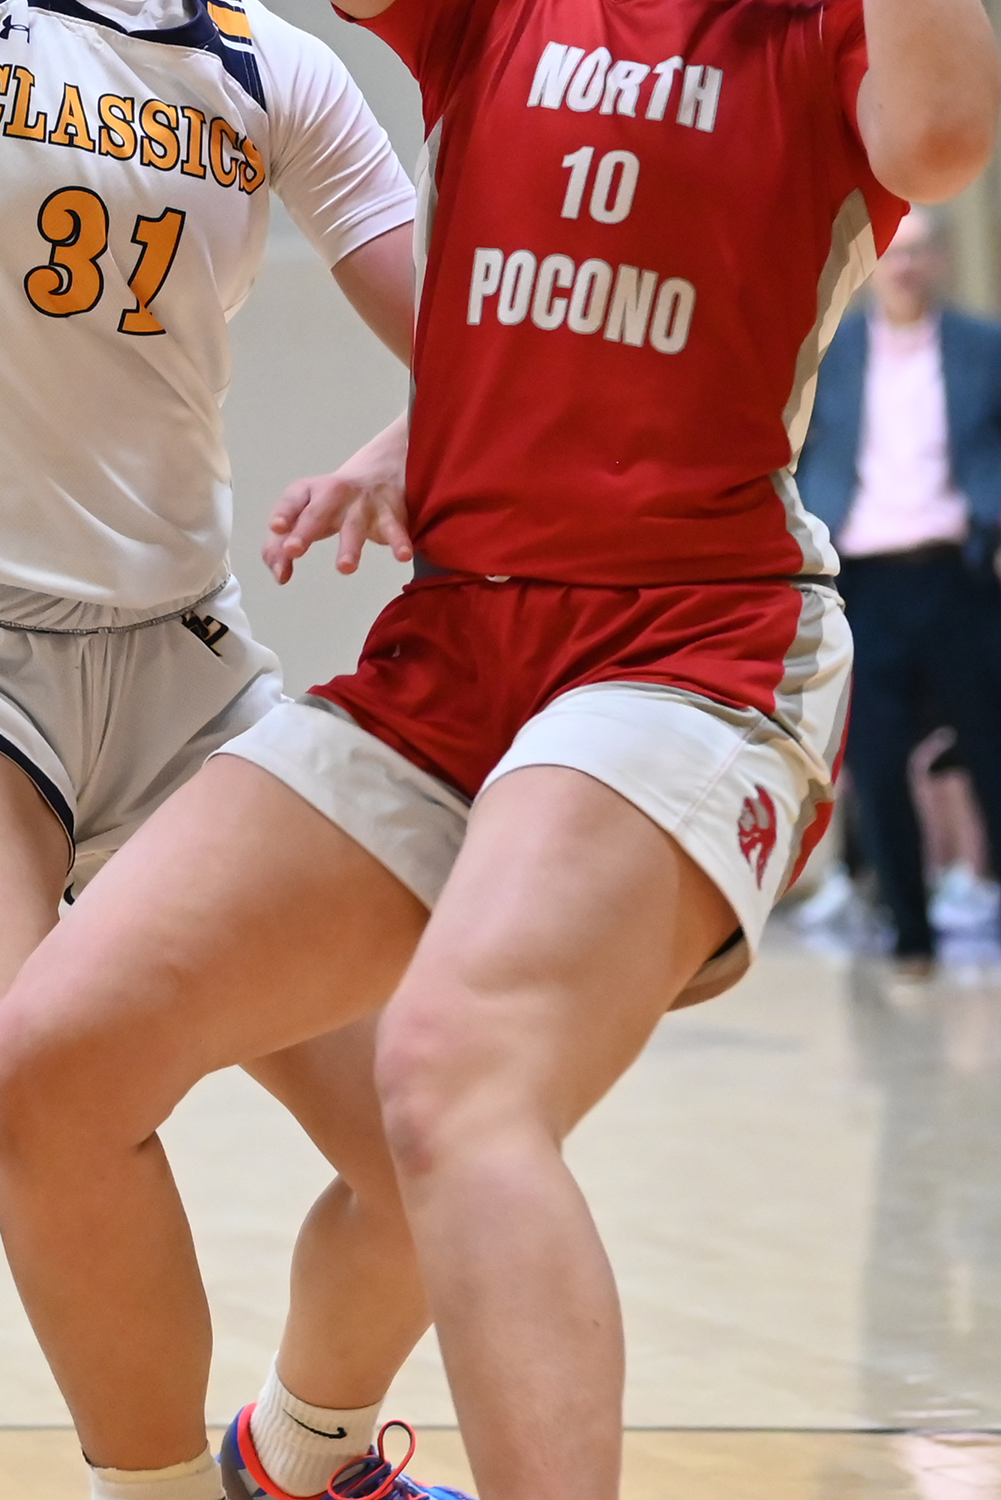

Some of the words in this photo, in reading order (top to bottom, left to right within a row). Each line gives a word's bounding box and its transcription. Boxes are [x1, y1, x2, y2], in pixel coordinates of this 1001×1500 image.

[527, 41, 723, 133] NORTH
[560, 146, 640, 224] 10
[23, 186, 186, 336] 31
[467, 247, 696, 355] POCONO
